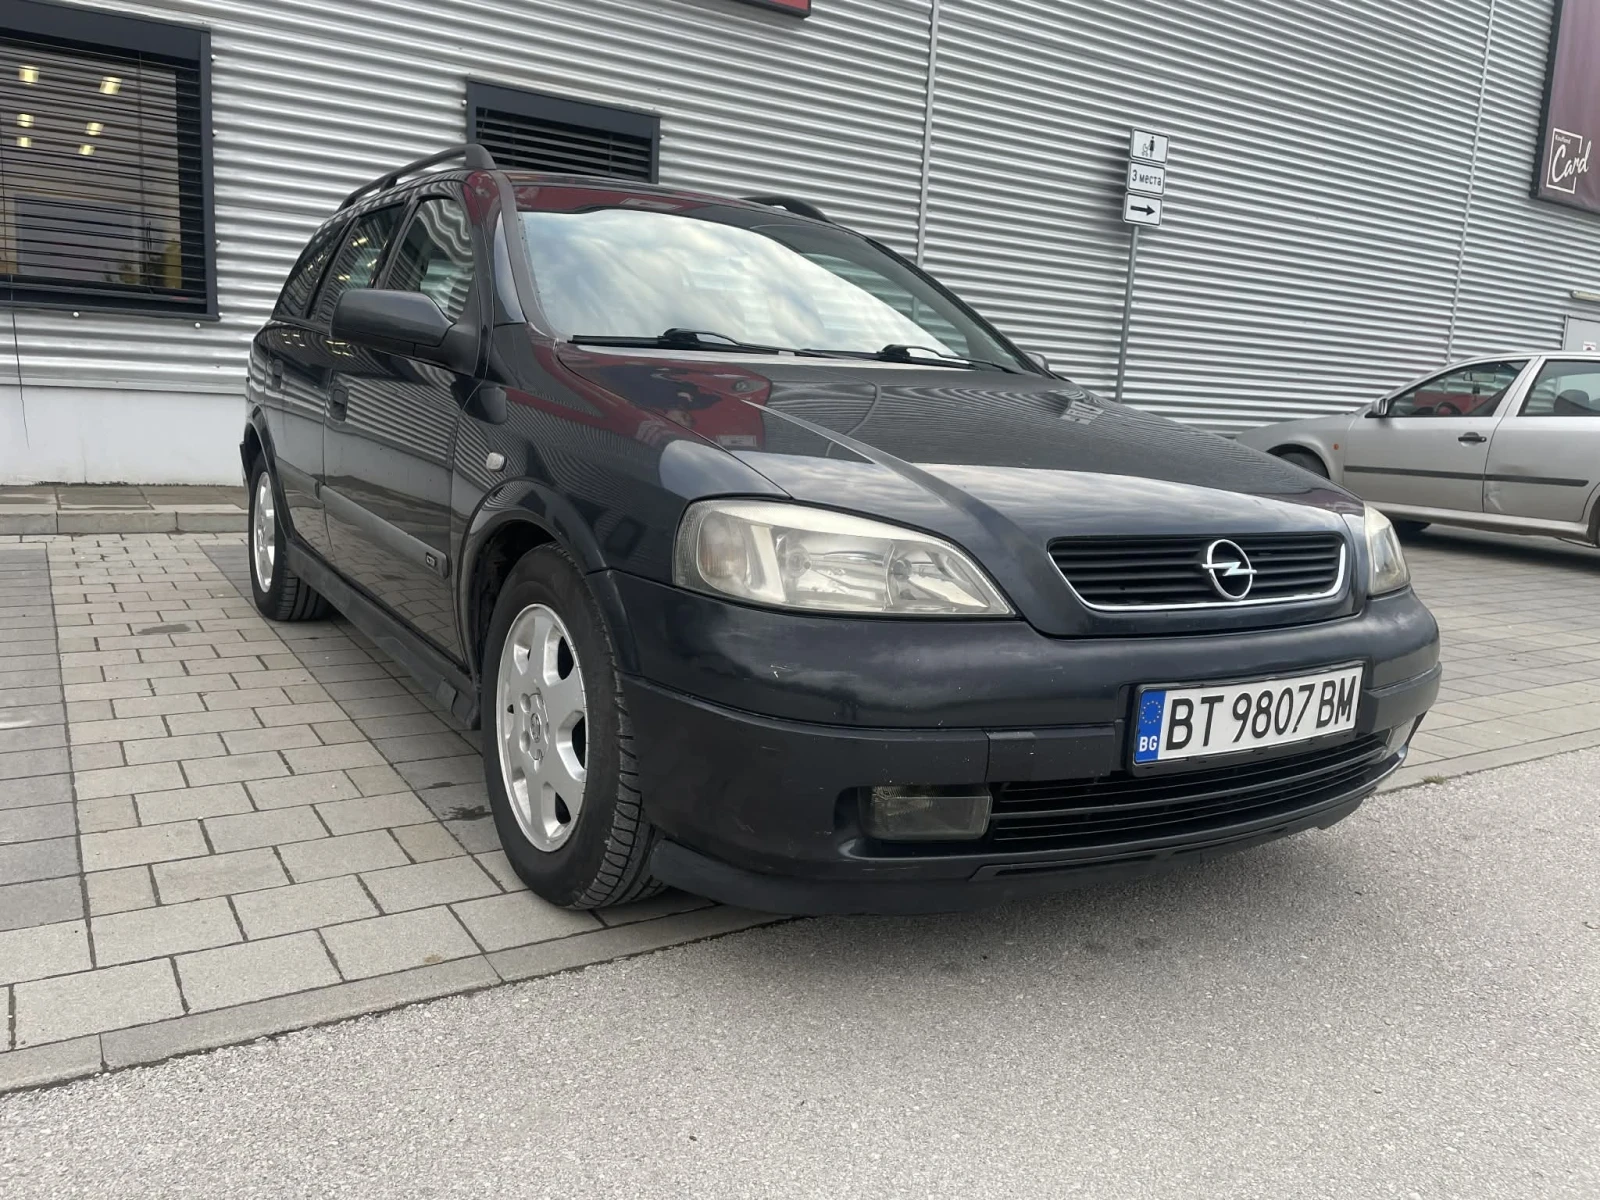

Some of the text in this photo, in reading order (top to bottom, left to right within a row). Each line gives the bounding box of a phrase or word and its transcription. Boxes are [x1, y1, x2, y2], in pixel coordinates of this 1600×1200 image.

[1552, 140, 1592, 182] Card
[1132, 169, 1162, 187] 3 места
[1166, 675, 1357, 751] BT 9807 BM
[1139, 735, 1158, 752] BG
